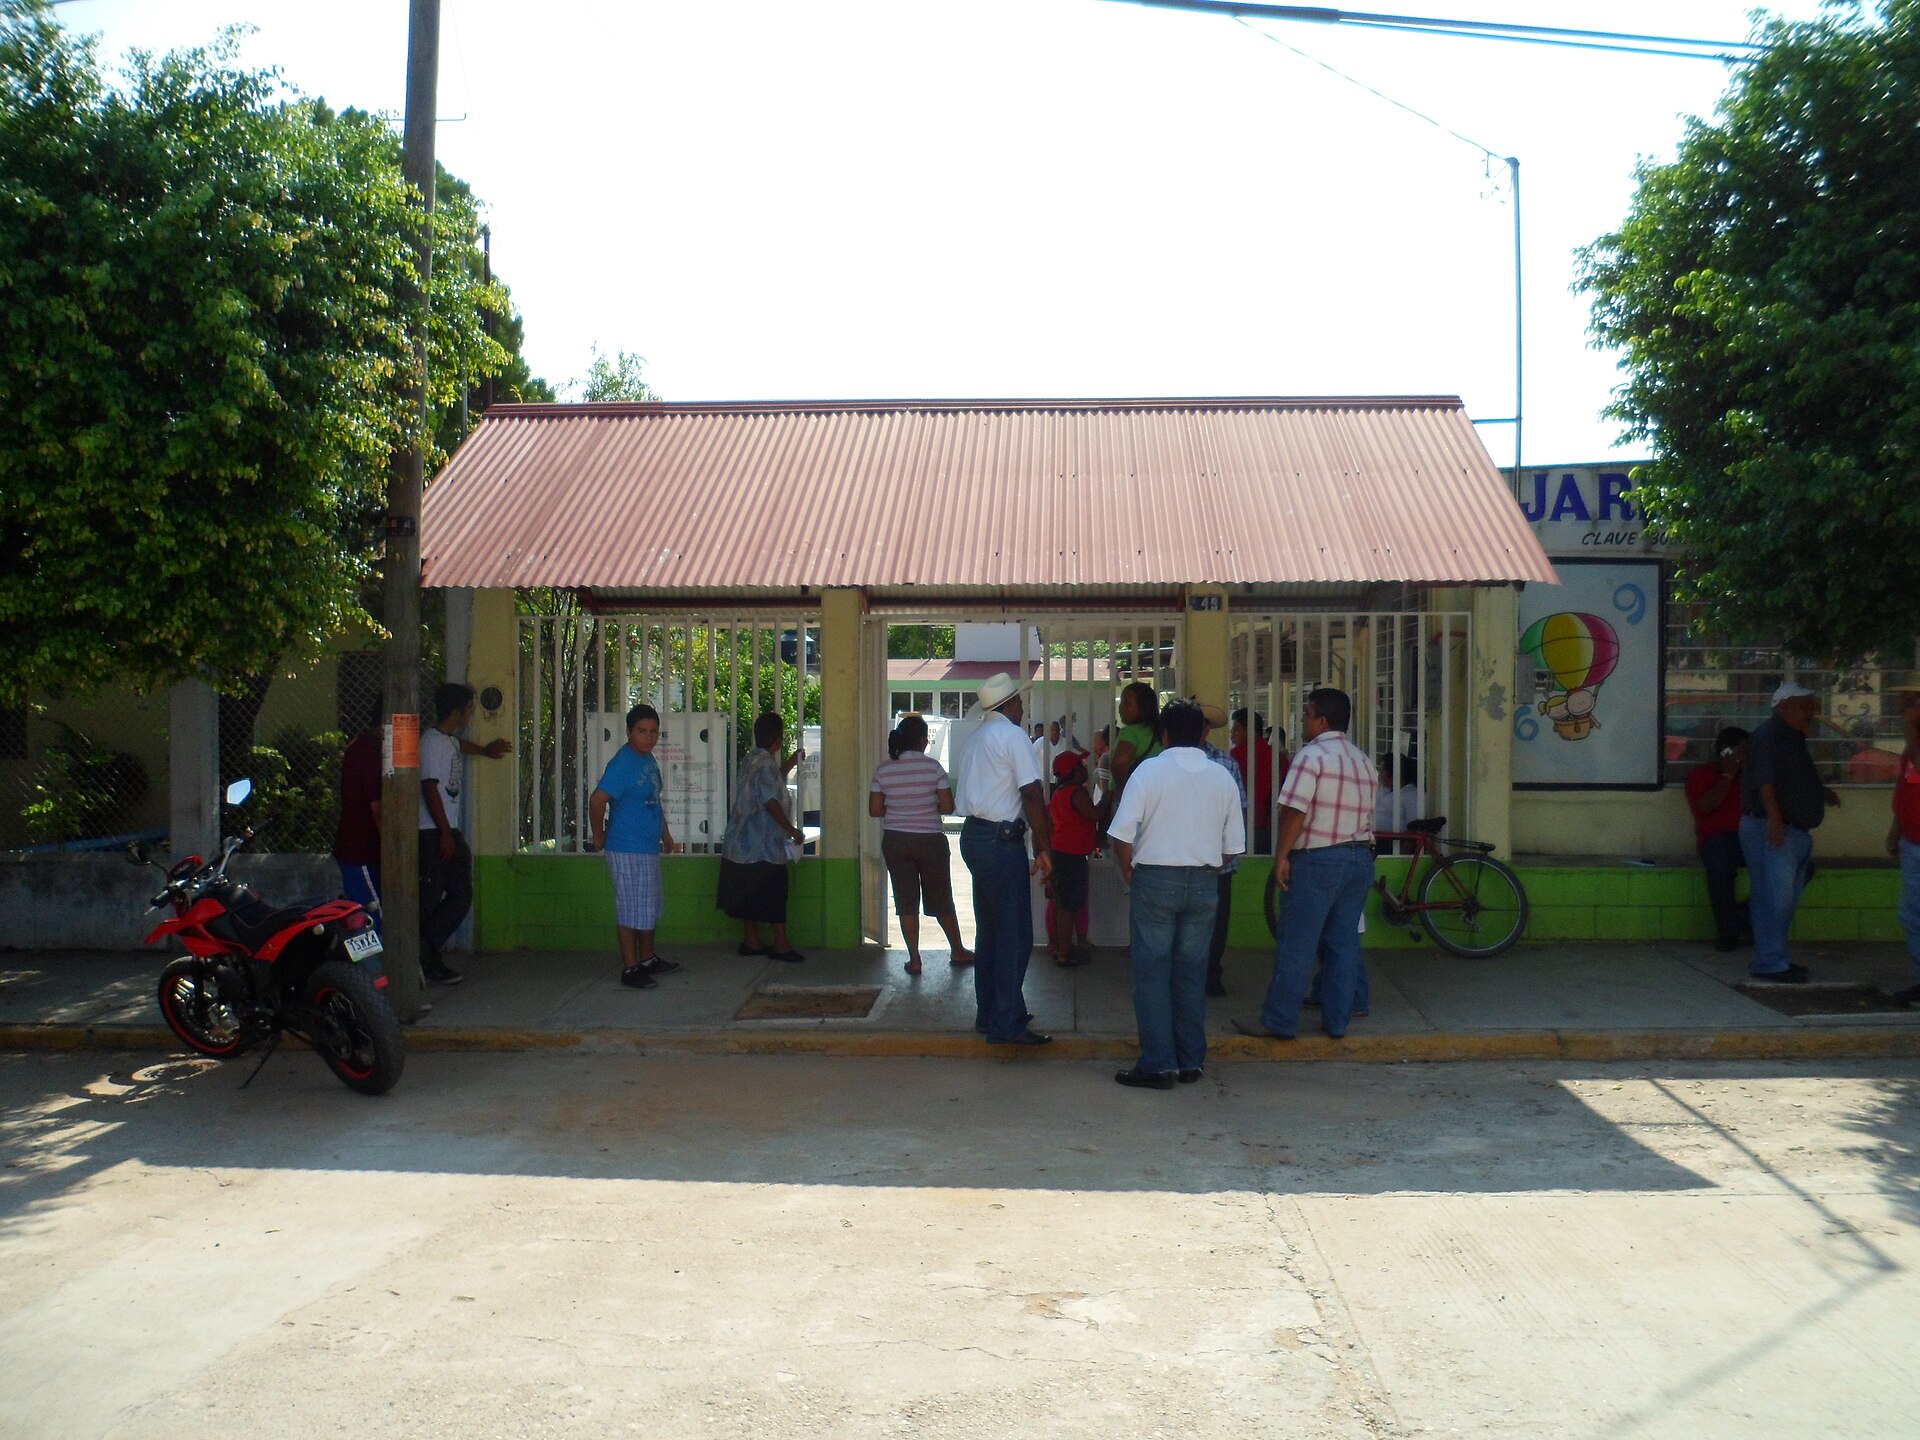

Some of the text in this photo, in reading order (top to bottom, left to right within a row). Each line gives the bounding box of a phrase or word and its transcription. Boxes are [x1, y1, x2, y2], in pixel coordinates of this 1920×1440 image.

[1581, 531, 1637, 546] CLAVE
[1612, 583, 1646, 625] 9
[1513, 705, 1539, 741] 6
